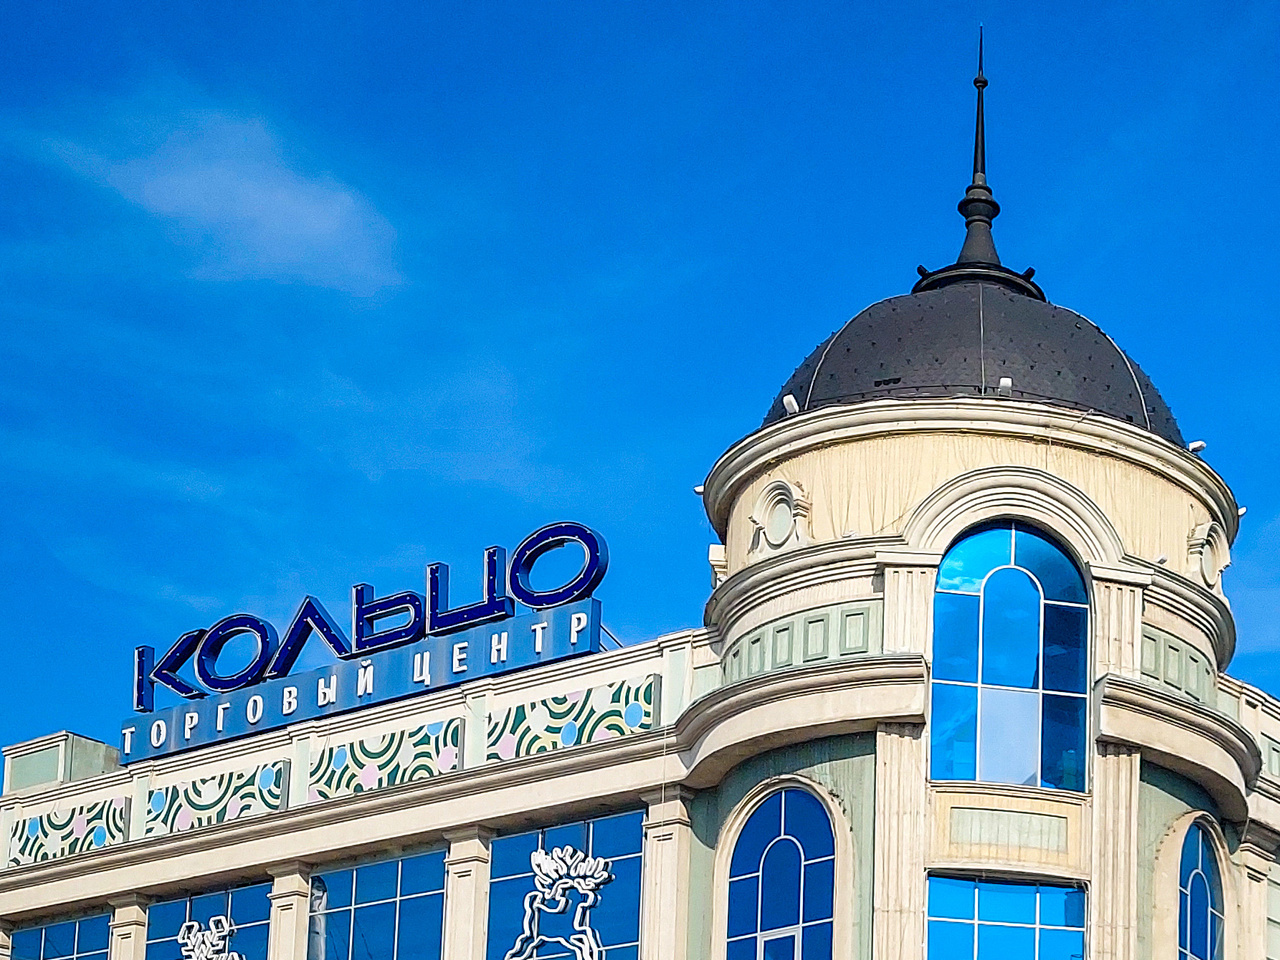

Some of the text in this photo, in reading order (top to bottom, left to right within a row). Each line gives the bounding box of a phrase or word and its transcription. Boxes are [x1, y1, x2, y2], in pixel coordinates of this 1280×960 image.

[121, 611, 589, 755] ТОРГОВЫЙ ЦЕНТР
[134, 520, 609, 713] КОЛЬЦО
